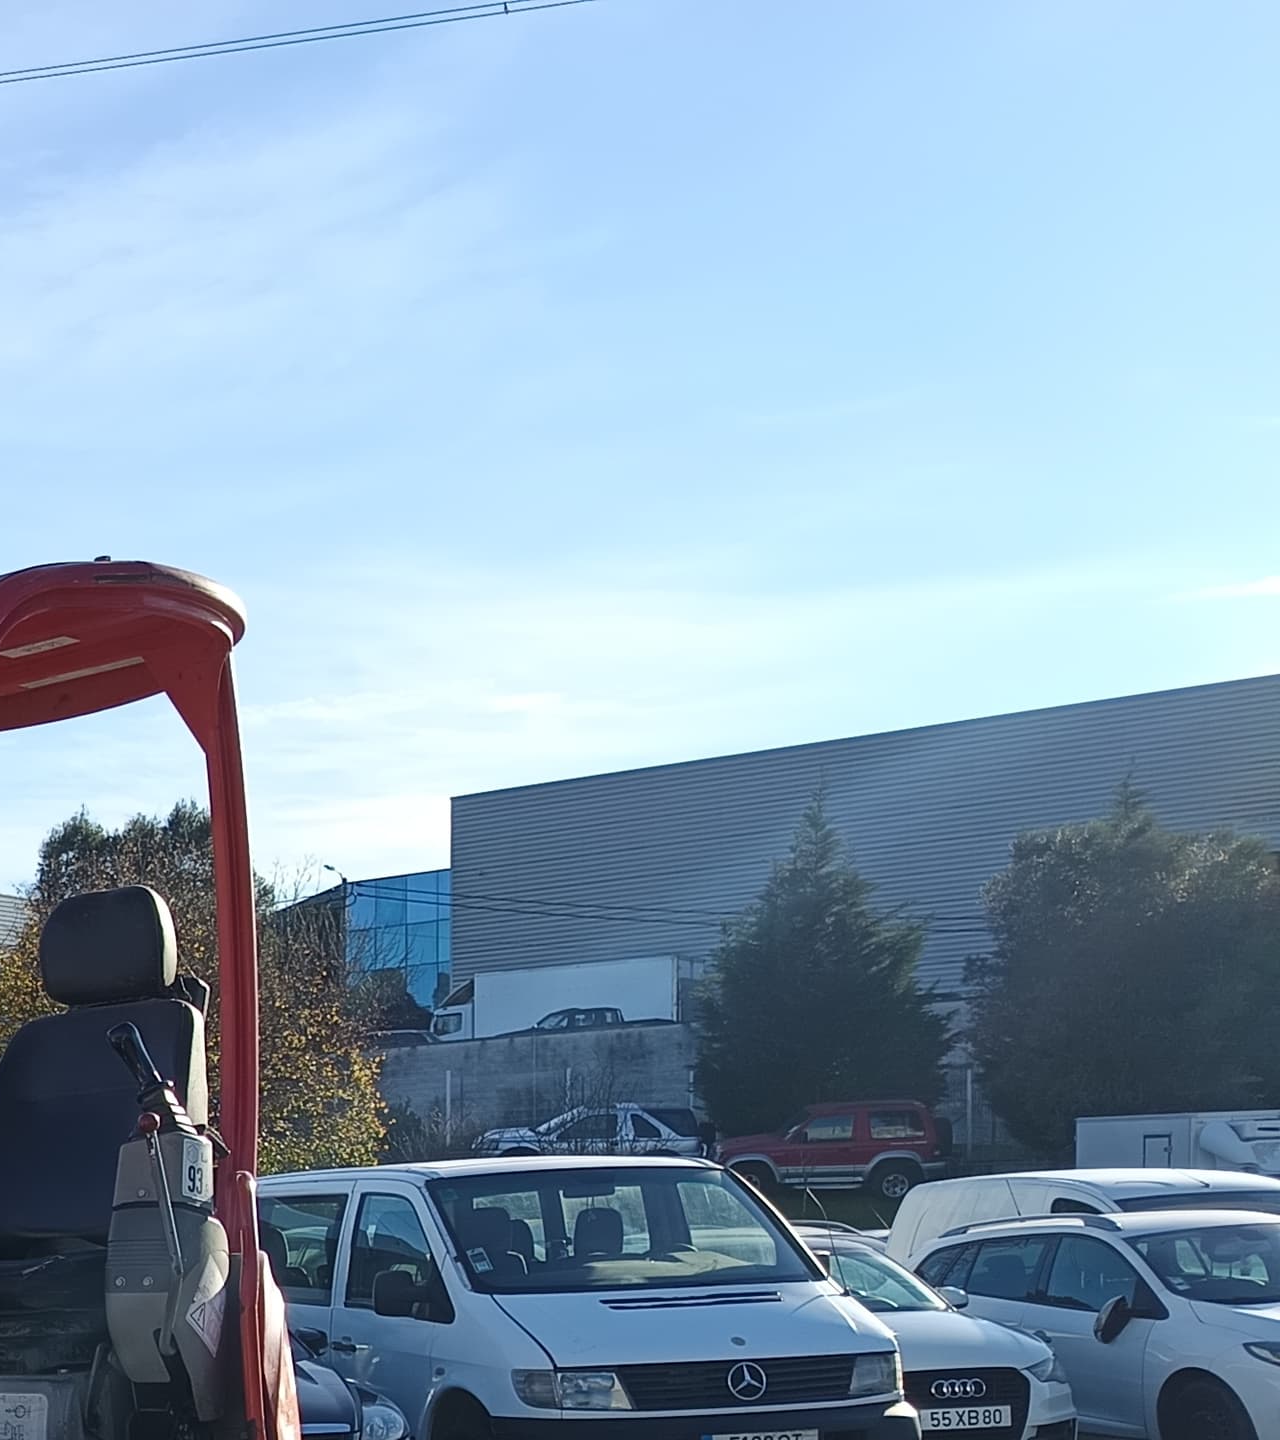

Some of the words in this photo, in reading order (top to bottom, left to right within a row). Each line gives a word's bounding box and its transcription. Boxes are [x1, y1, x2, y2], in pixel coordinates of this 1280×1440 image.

[187, 1165, 203, 1195] 93
[930, 1411, 952, 1428] 55
[955, 1409, 980, 1426] XB
[982, 1408, 1002, 1425] 80
